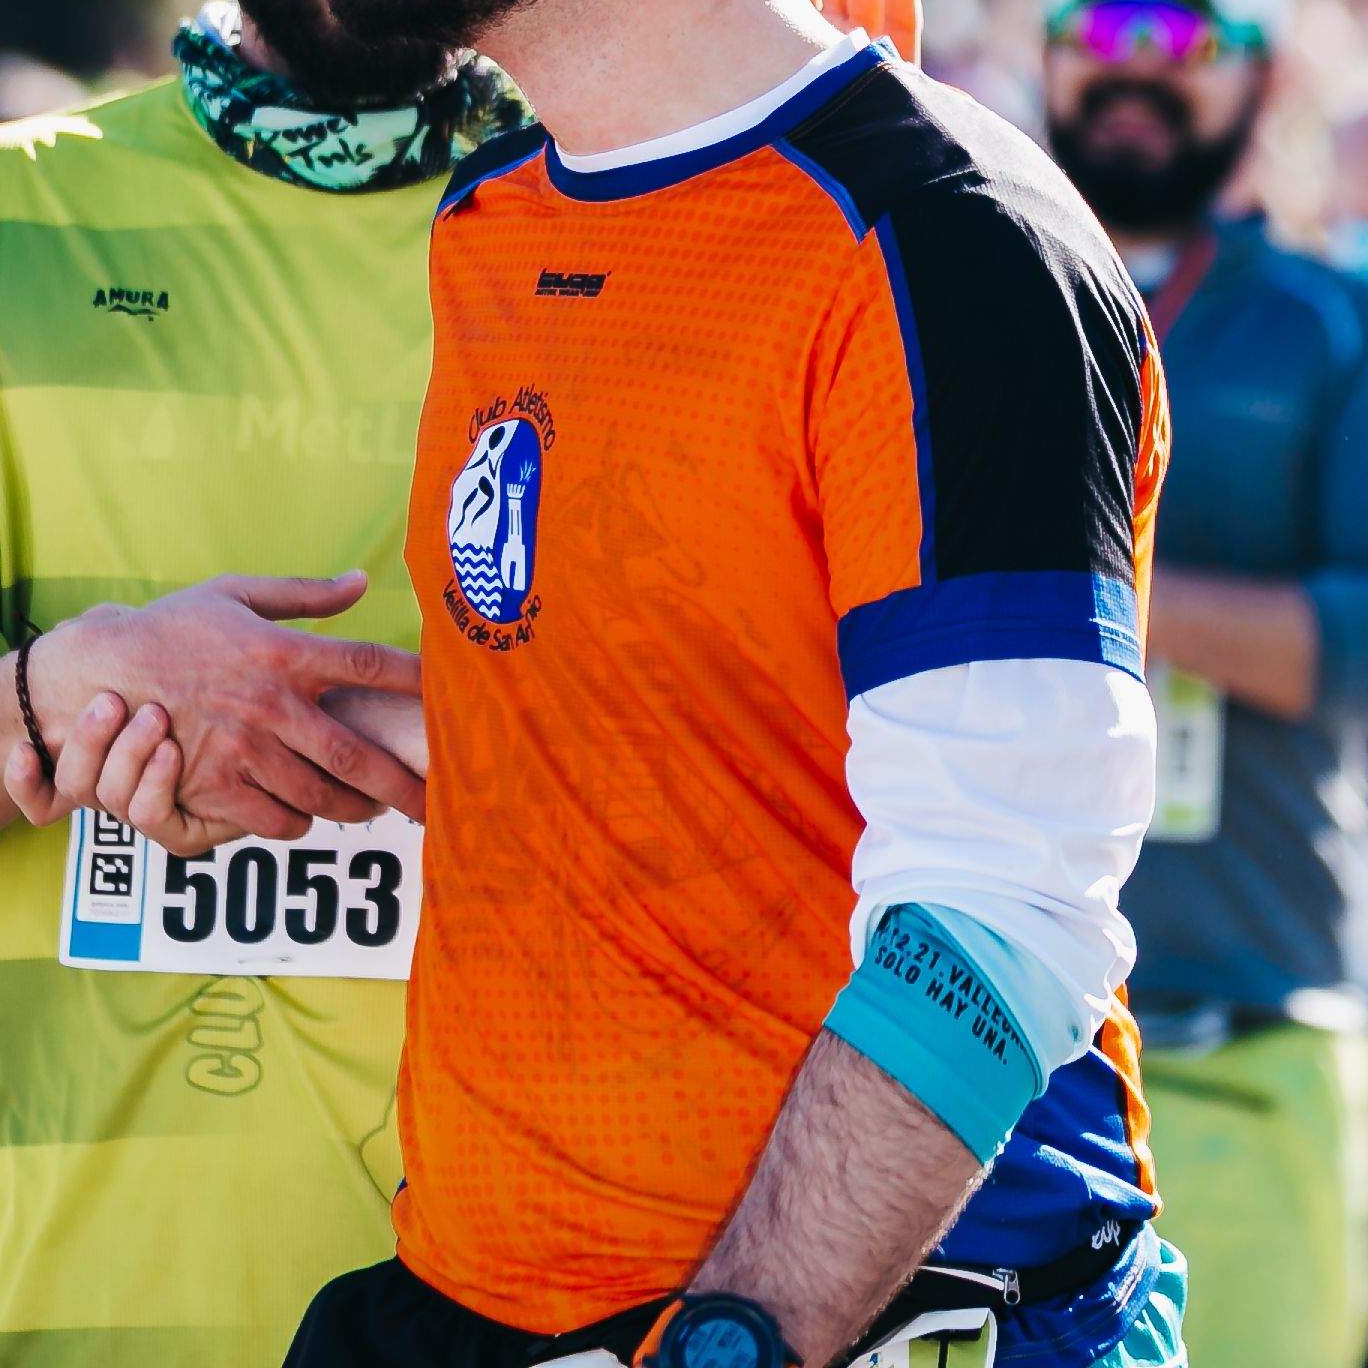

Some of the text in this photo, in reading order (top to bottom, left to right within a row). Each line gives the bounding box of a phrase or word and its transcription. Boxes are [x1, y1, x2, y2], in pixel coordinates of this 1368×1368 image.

[93, 288, 169, 311] AMURA
[468, 396, 507, 444] Club
[162, 846, 404, 947] 5053
[874, 944, 1008, 1066] SOLO HAY UNA.
